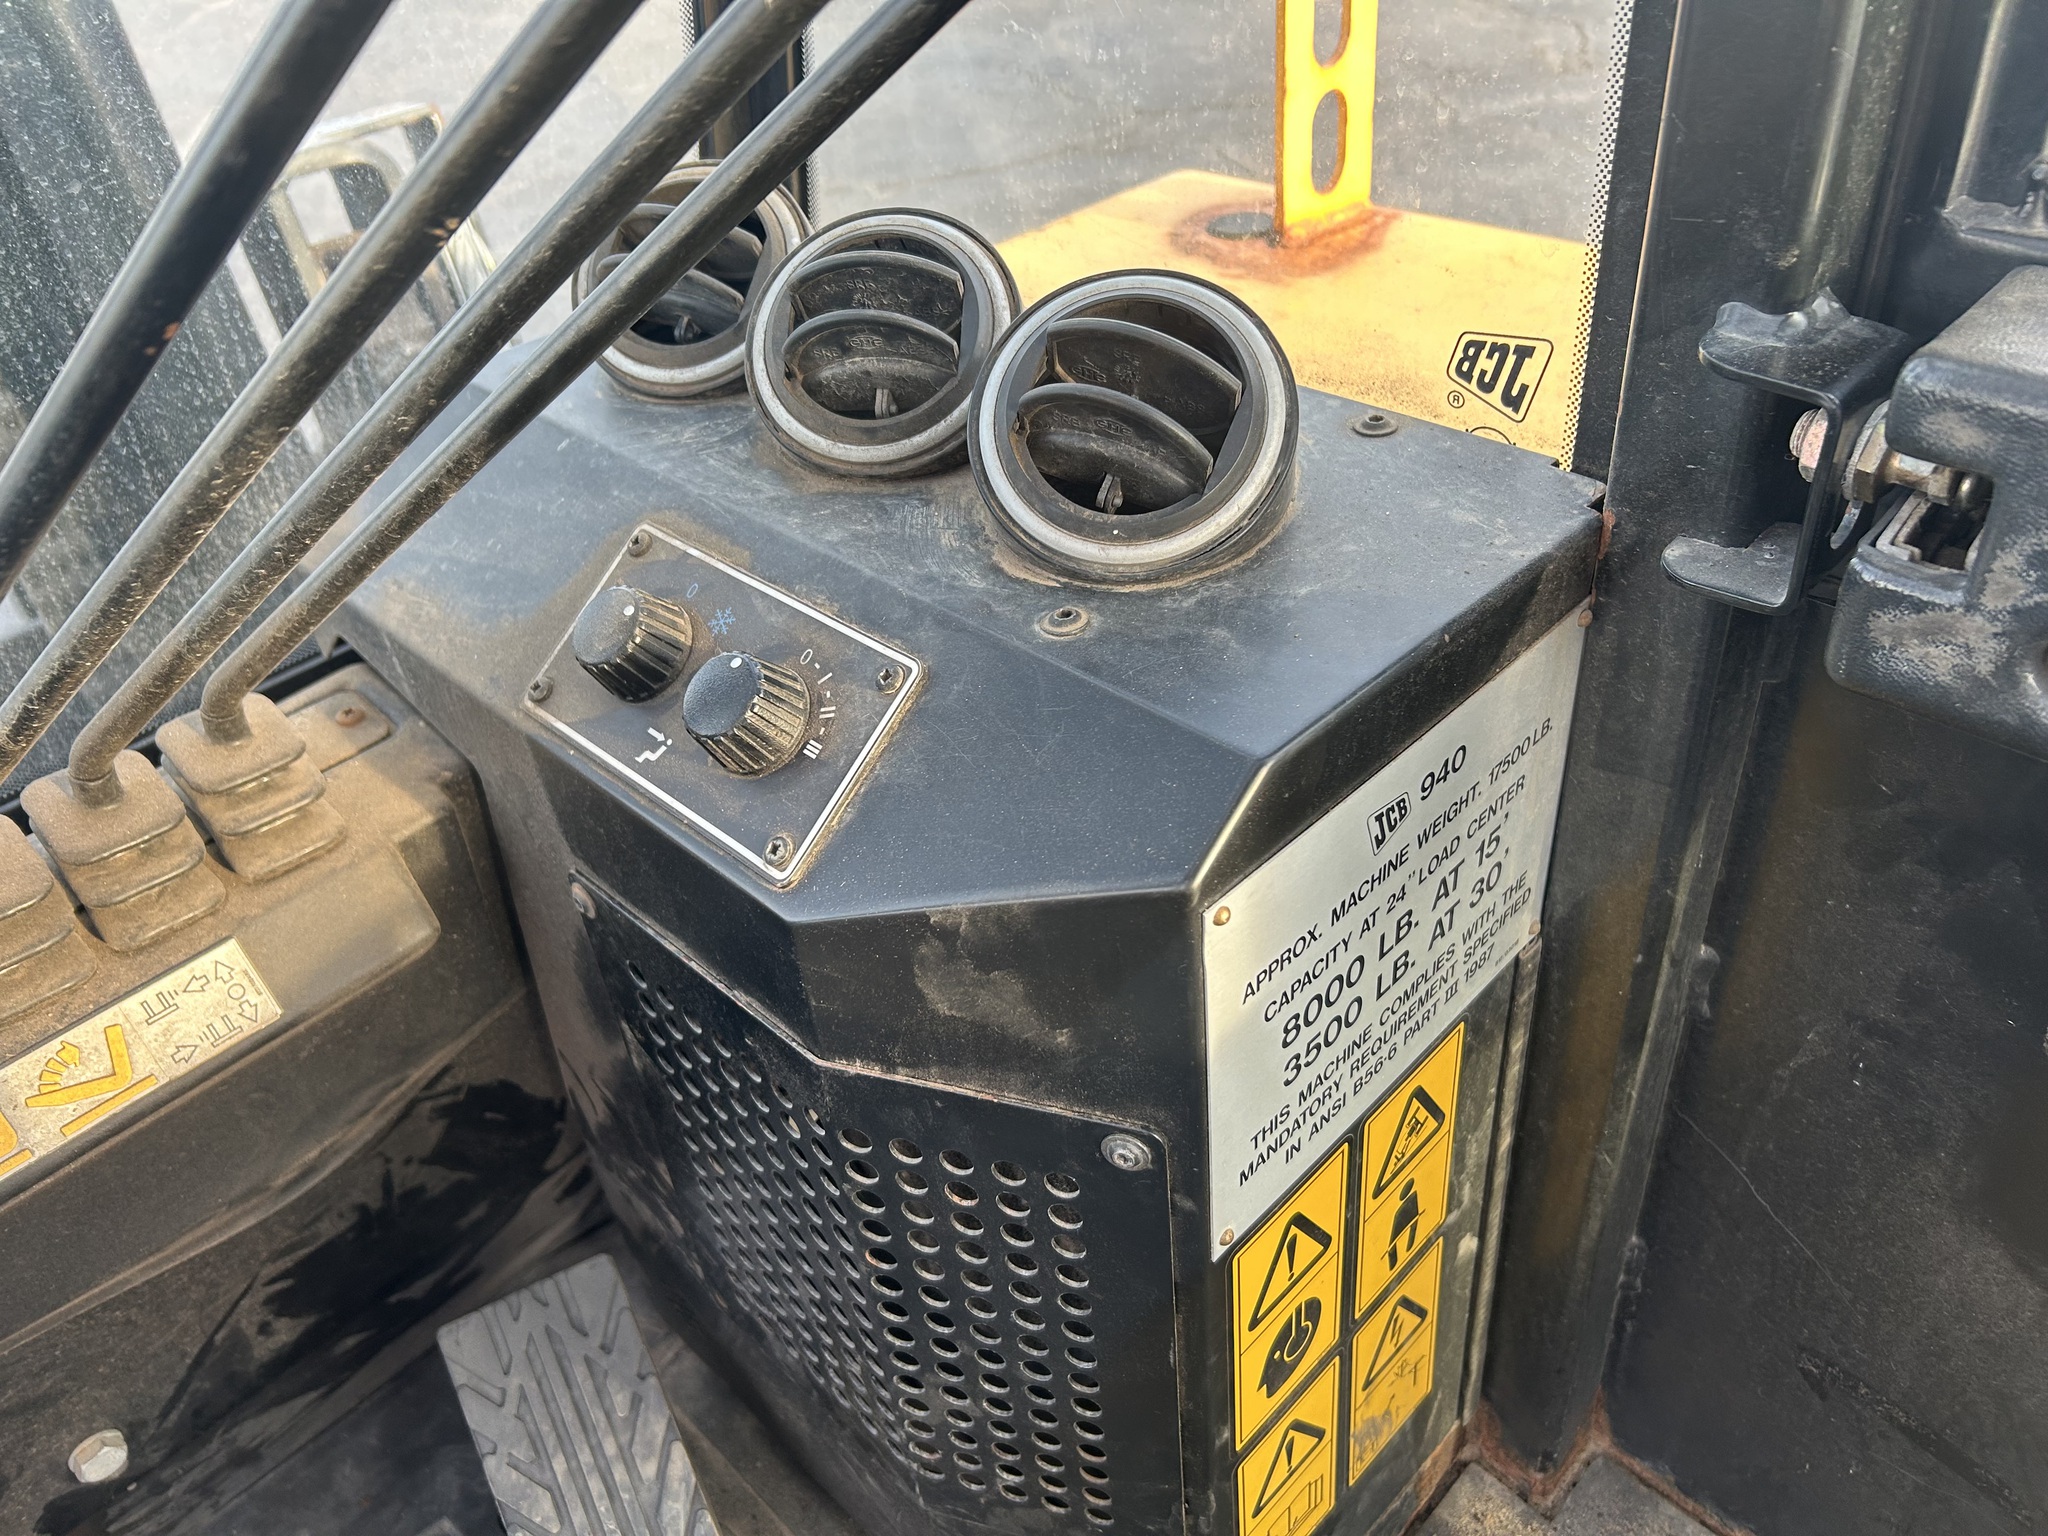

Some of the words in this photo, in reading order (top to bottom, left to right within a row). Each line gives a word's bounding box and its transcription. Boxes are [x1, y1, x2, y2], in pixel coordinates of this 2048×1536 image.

[1242, 923, 1323, 1005] APPROX.
[1331, 843, 1410, 927] MACHINE
[1417, 781, 1482, 850] WEIGHT.
[1488, 736, 1531, 786] 17500
[1532, 717, 1553, 747] LB.
[1264, 931, 1353, 1023] CAPACITY
[1359, 906, 1380, 940] AT
[1418, 835, 1460, 886] LOAD
[1466, 774, 1526, 839] CENTER
[1374, 797, 1408, 850] JCB
[1420, 745, 1467, 801] 940
[1239, 1073, 1343, 1187] MANDATORY
[1350, 959, 1459, 1078] REQUIREMENT
[1462, 887, 1531, 965] SPECIFIED
[1250, 1104, 1290, 1150] THIS
[1298, 1023, 1373, 1107] MACHINE
[1379, 942, 1456, 1026] COMPLIES
[1461, 901, 1497, 946] WITH
[1501, 870, 1528, 906] THE
[1281, 954, 1365, 1049] 8000
[1378, 908, 1420, 962] LB.
[1431, 857, 1466, 912] AT
[1283, 995, 1363, 1087] 3500
[1375, 949, 1416, 1002] LB.
[1428, 899, 1461, 952] AT
[1285, 1137, 1301, 1164] IN
[1308, 1092, 1347, 1142] ANSI
[1403, 998, 1440, 1046] PART
[1443, 978, 1460, 1005] III
[1463, 941, 1496, 983] 1987
